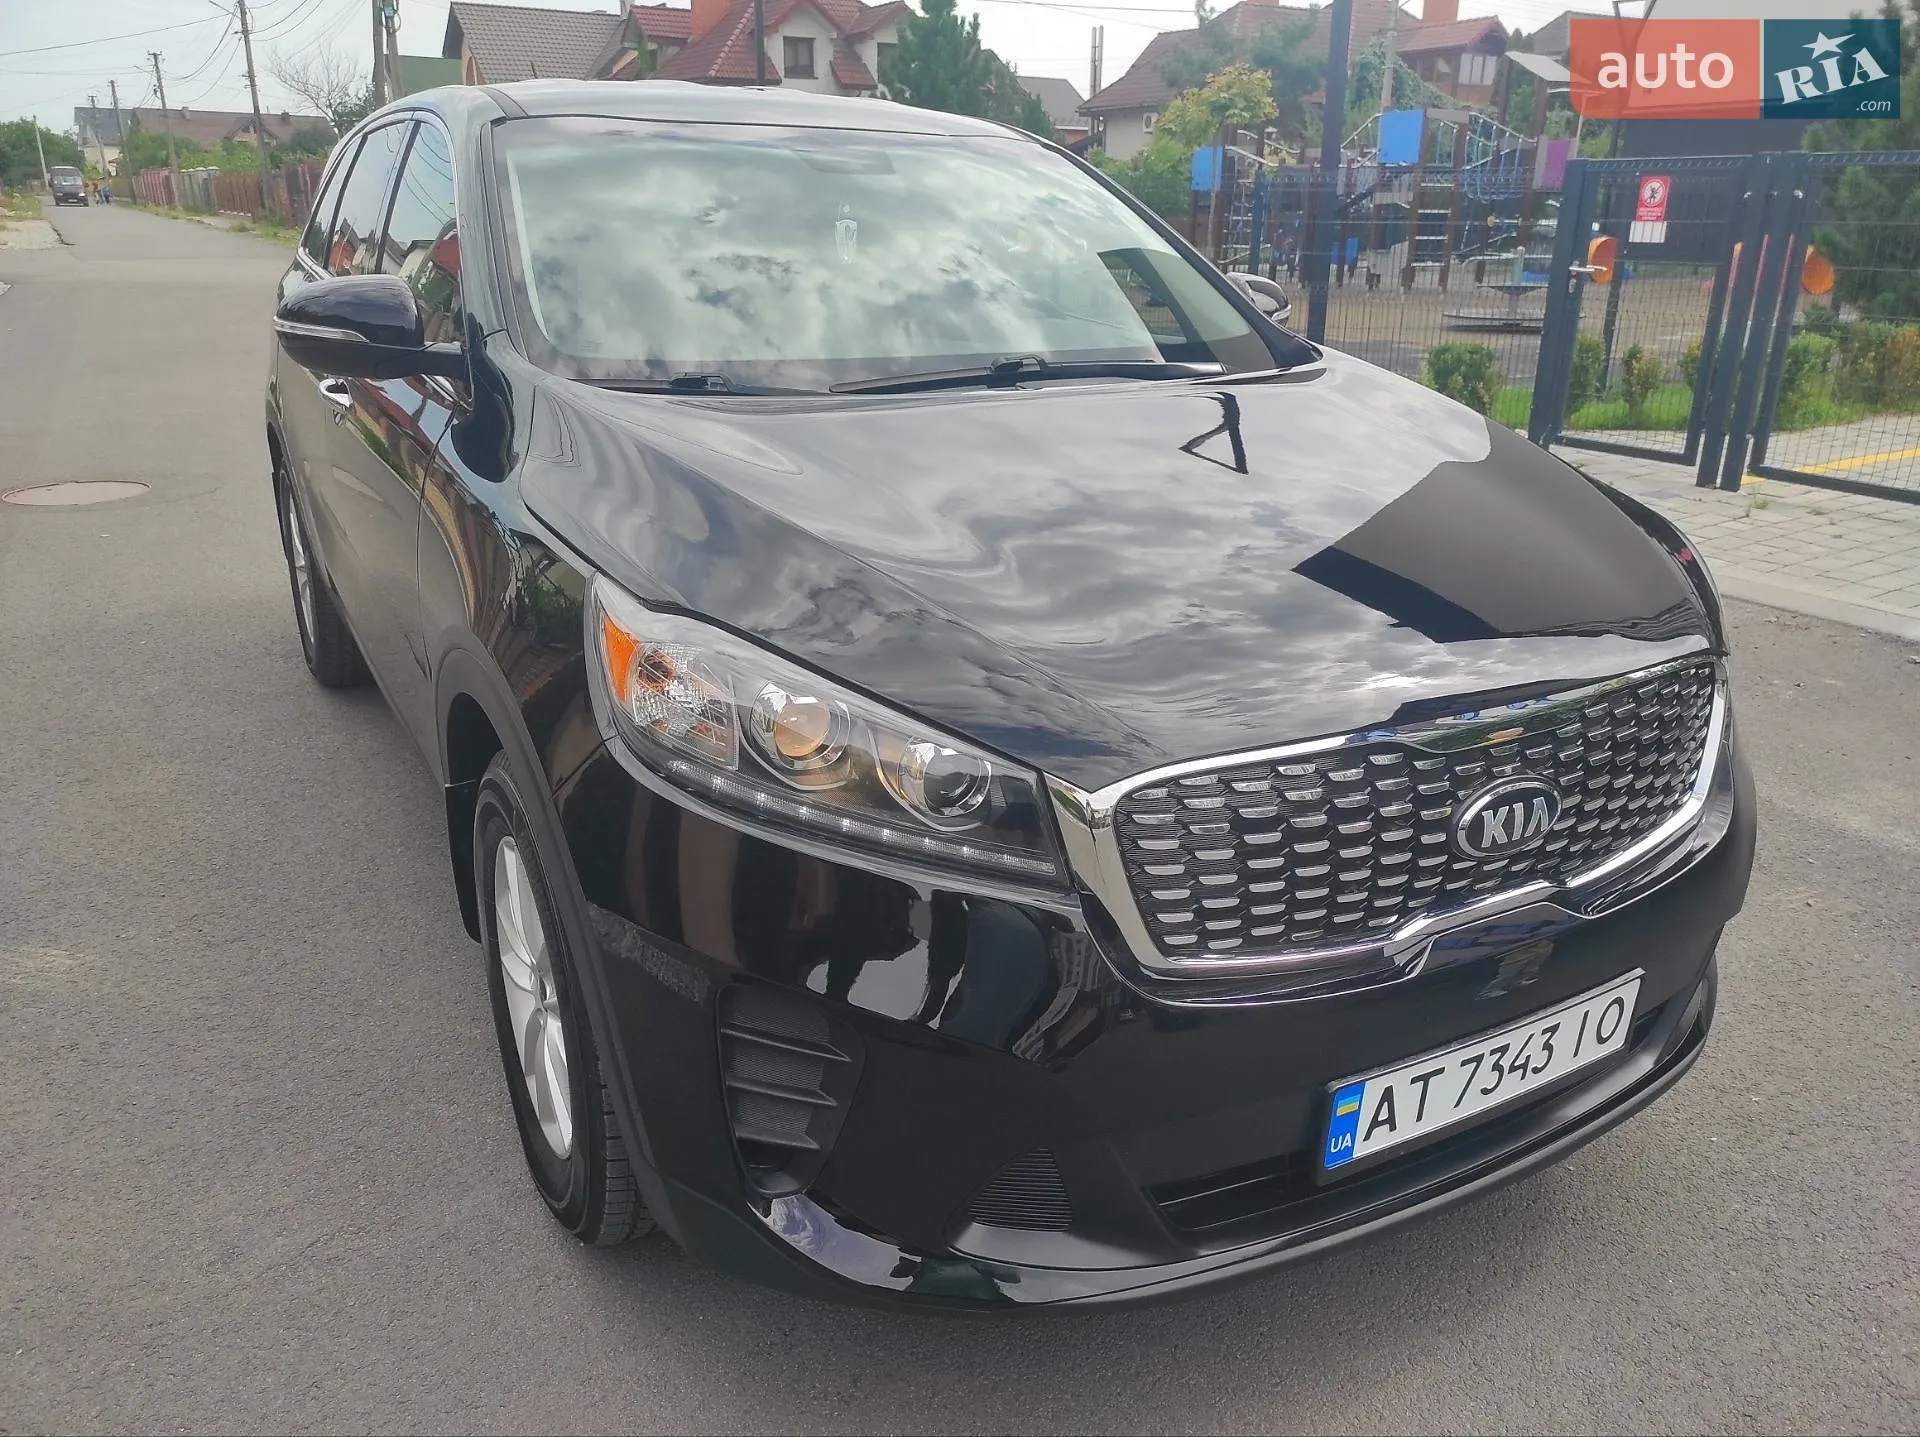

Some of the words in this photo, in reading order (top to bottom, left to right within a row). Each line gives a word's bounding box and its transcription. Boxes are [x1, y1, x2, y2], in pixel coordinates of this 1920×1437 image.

[1480, 797, 1549, 848] KIA
[1362, 1066, 1445, 1142] AT
[1453, 1022, 1561, 1109] 7343
[1572, 996, 1625, 1058] IO
[1330, 1134, 1352, 1153] UA
